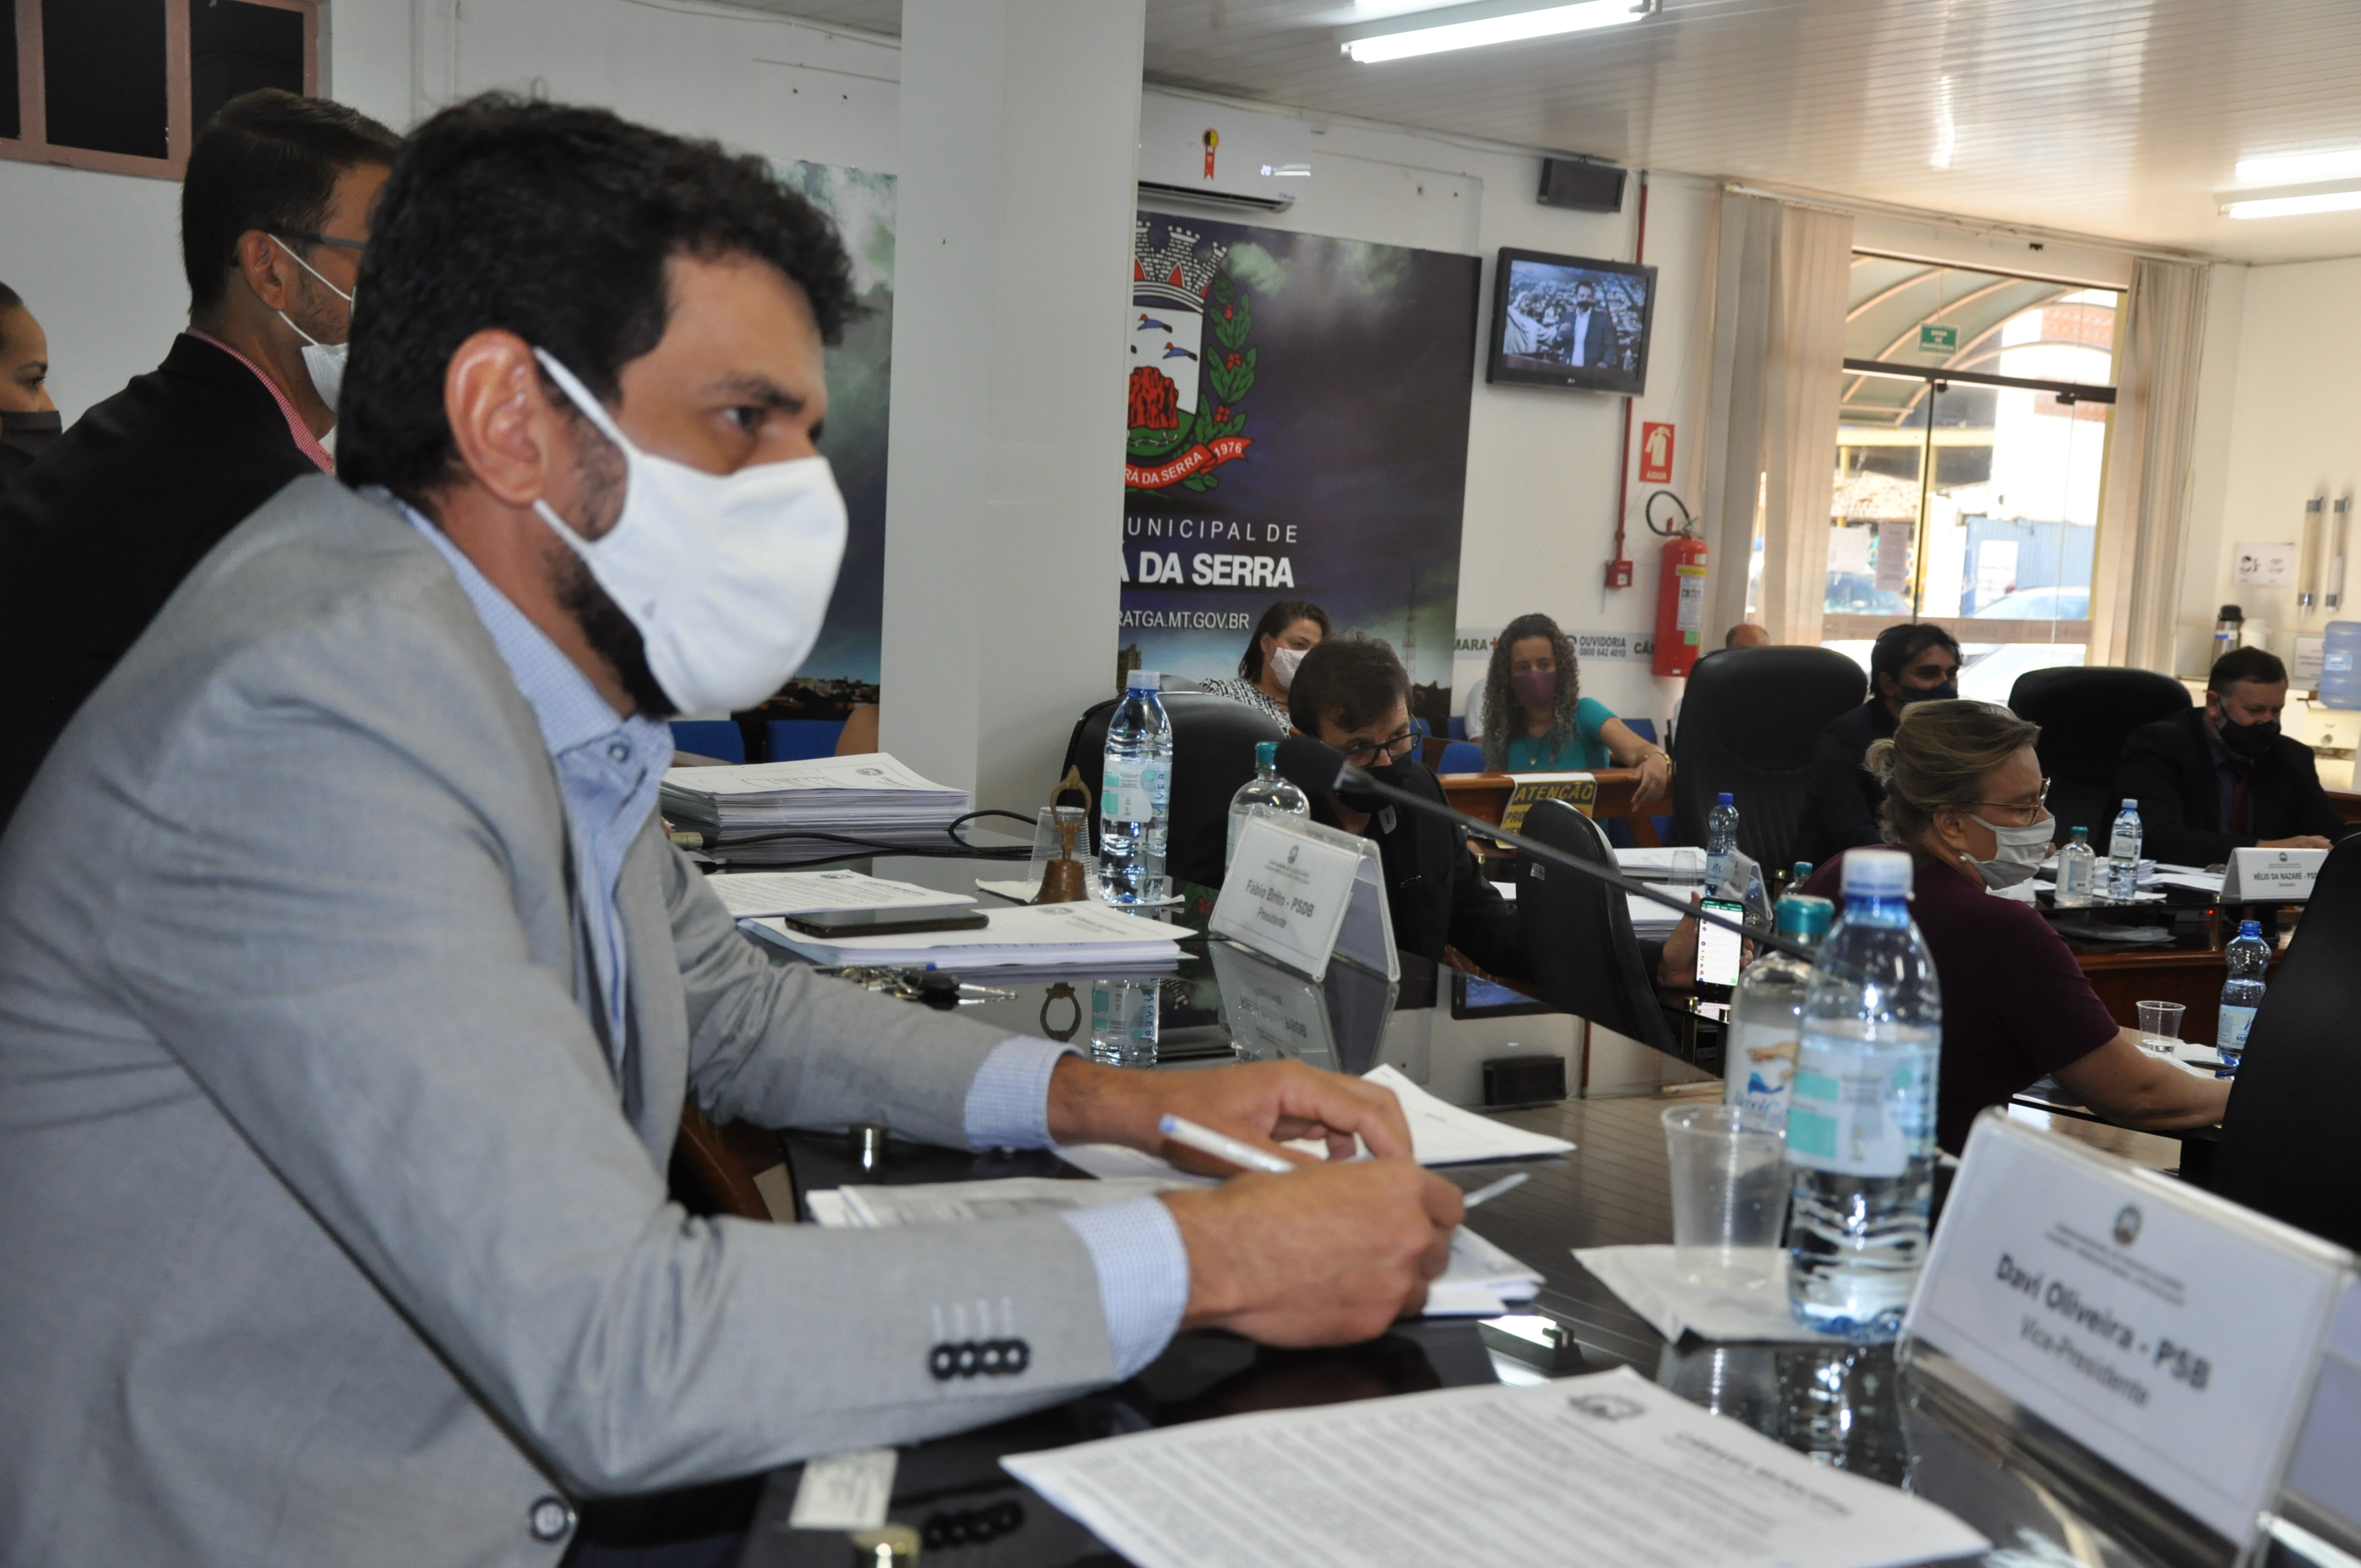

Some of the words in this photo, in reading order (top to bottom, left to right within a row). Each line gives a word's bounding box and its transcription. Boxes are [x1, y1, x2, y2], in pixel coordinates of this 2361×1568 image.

[1214, 442, 1242, 457] 1976
[1142, 472, 1160, 484] DA
[1161, 452, 1203, 482] SERRA
[1128, 517, 1256, 541] UNICIPAL
[1267, 524, 1297, 543] DE
[1139, 551, 1184, 584] DA
[1192, 552, 1294, 588] SERRA
[1579, 636, 1626, 647] OUVIDORIA
[1515, 781, 1594, 801] ATENÇÃO
[2046, 1280, 2134, 1352] Oliveira
